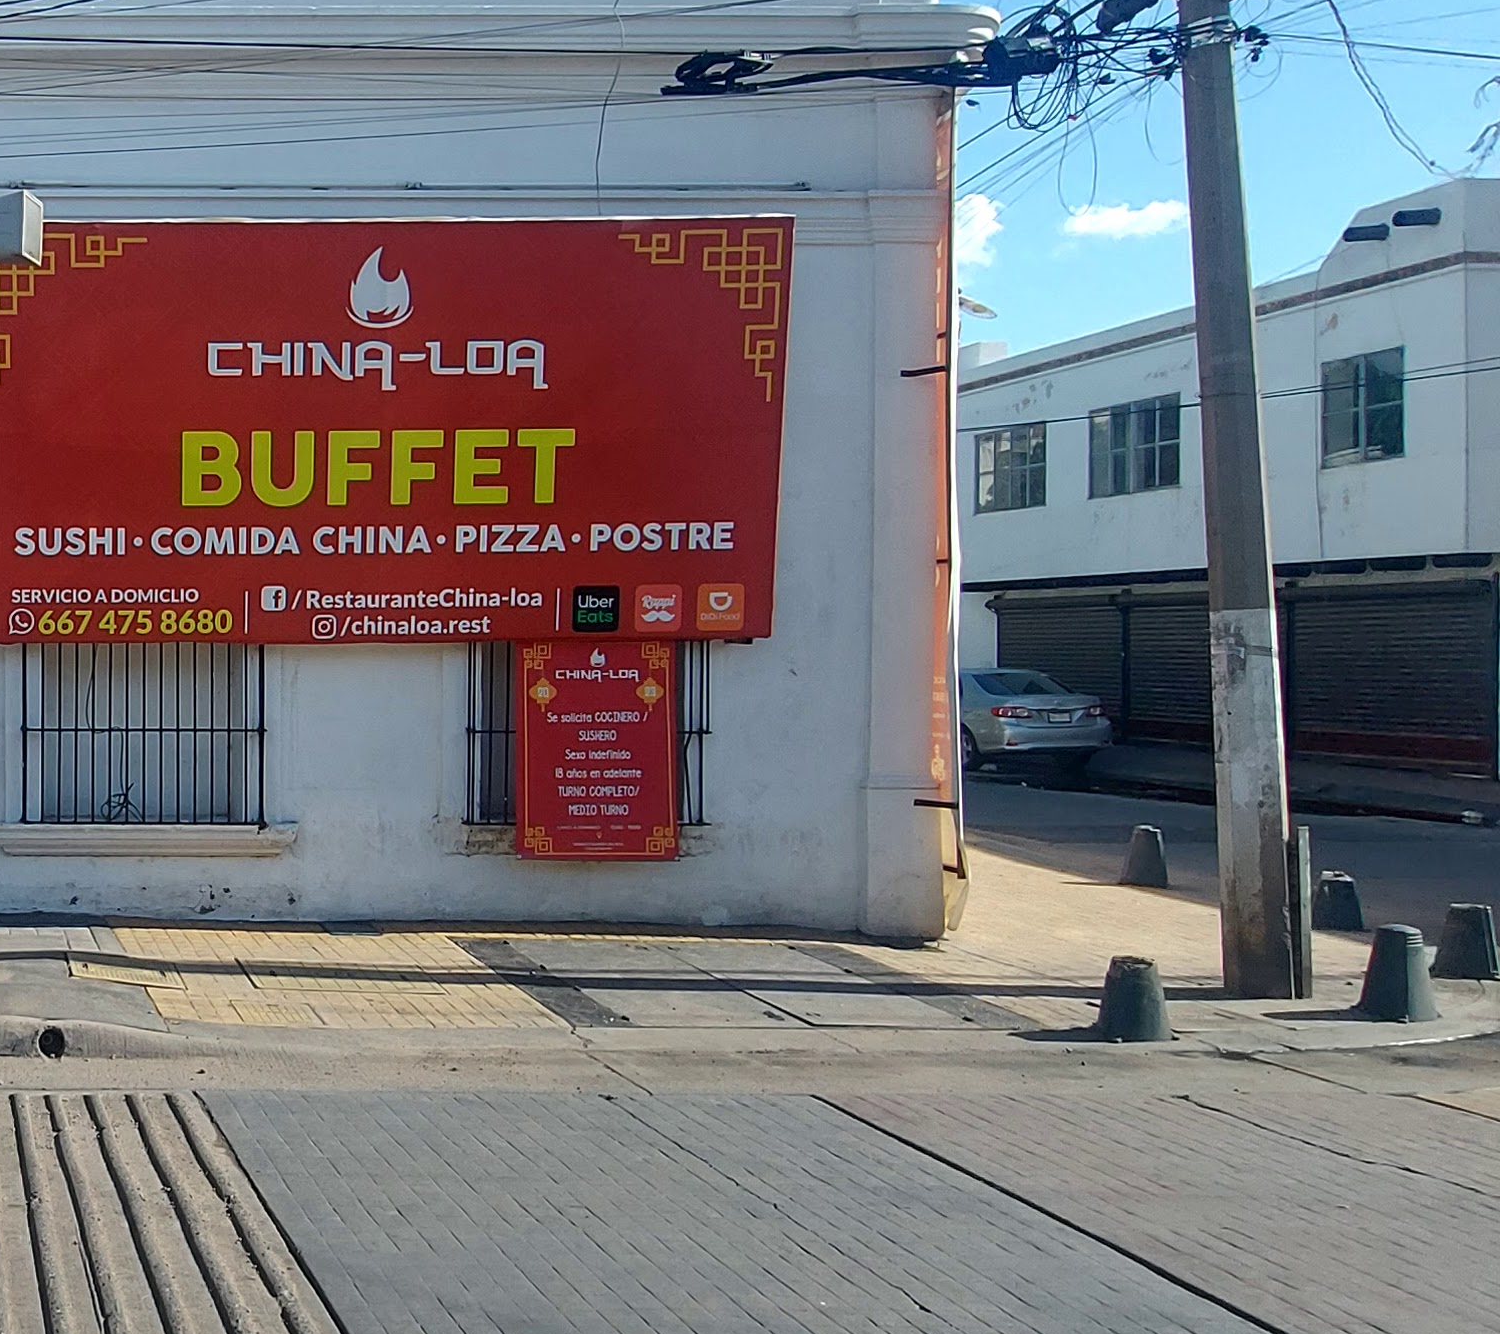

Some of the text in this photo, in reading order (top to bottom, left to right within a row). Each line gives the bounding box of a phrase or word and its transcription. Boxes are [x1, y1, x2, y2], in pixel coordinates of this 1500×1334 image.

[207, 338, 549, 391] CHINA-LOA
[181, 427, 576, 507] BUFFET
[13, 521, 735, 556] SUSHI COMIDA CHINA PIZZA POSTRE
[11, 588, 199, 604] SERVICIO A DOMICLIO
[577, 594, 614, 609] Uber
[37, 609, 233, 635] 667 475 8680
[577, 610, 613, 623] Eats
[555, 669, 640, 683] CHINA-LOA
[547, 711, 559, 723] Se
[560, 712, 593, 723] solicita
[594, 711, 640, 723] COCINERO
[578, 730, 617, 741] SUSHERO
[565, 748, 586, 760] Sexo
[555, 768, 642, 779] 18 años en adelante
[557, 785, 587, 797] TURNO
[568, 804, 629, 816] MEDIO TURNO
